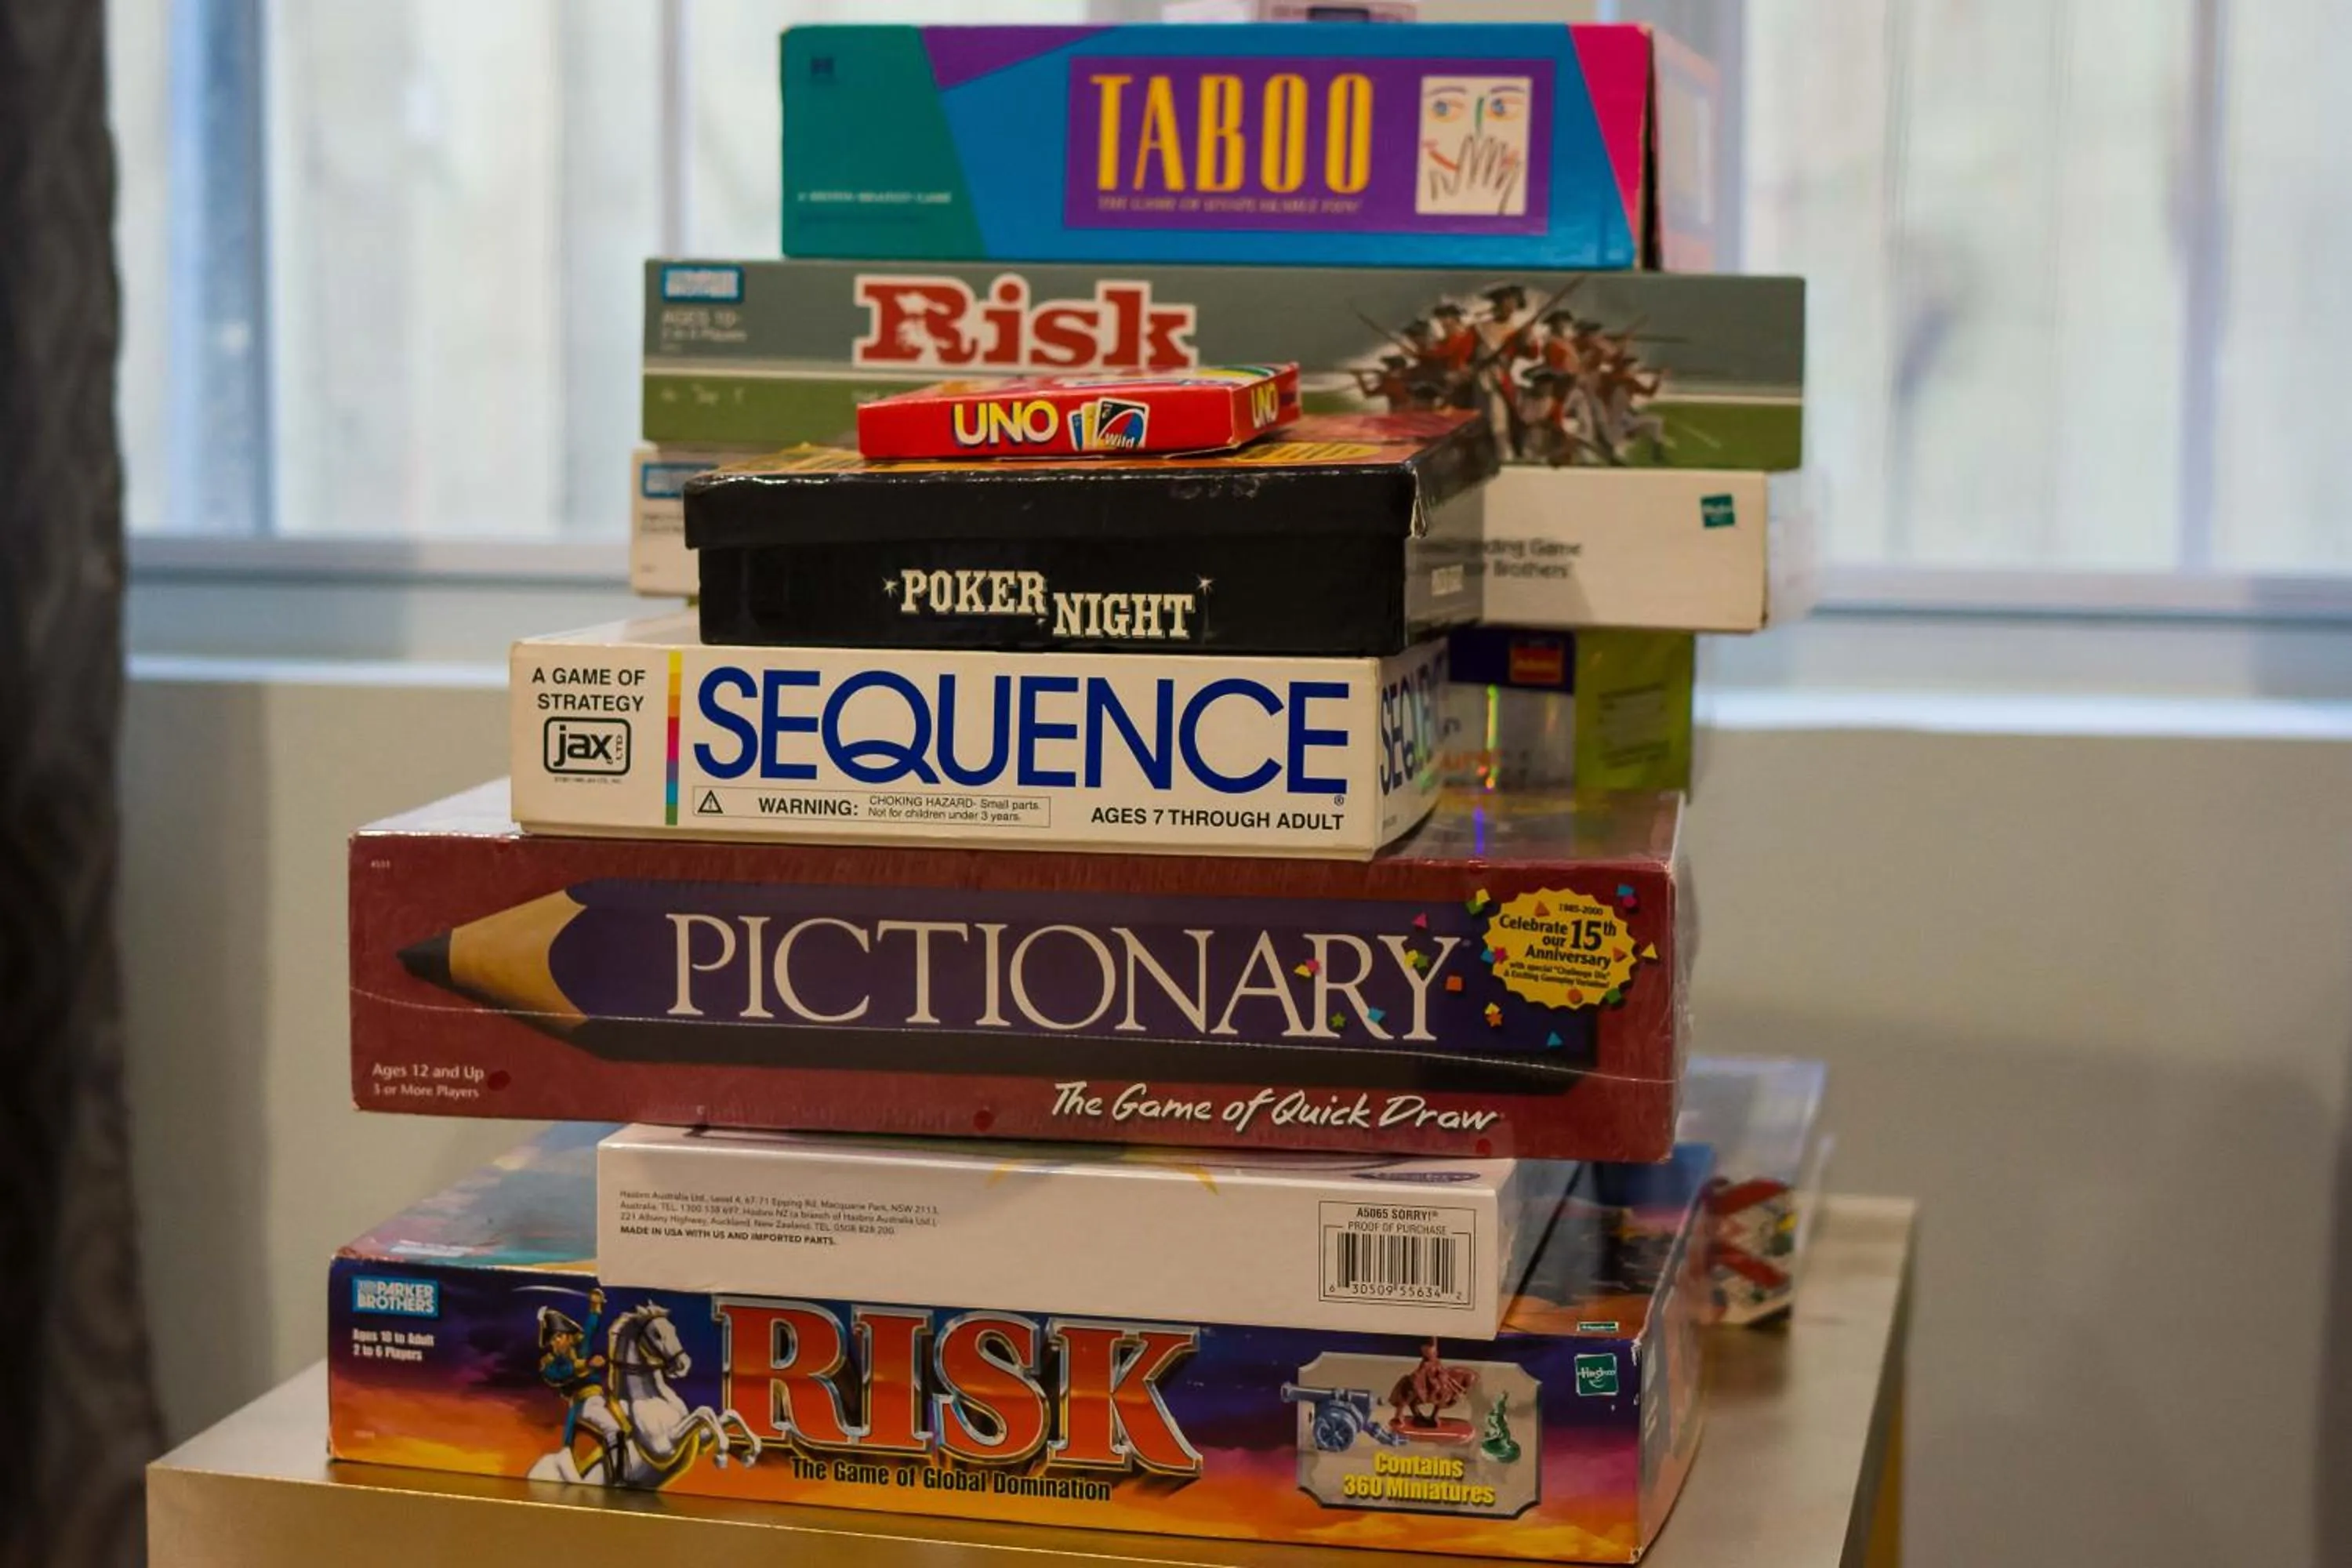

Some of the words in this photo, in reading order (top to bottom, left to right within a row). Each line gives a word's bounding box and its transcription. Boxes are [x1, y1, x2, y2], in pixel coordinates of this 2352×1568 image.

[1091, 73, 1374, 194] TABOO
[853, 274, 1200, 372] Risk
[1251, 383, 1279, 429] UNO
[952, 401, 1058, 447] UNO
[900, 569, 1048, 615] POKER
[1053, 593, 1196, 639] NIGHT
[532, 667, 546, 684] A
[552, 668, 612, 685] GAME
[618, 670, 646, 686] OF
[537, 693, 644, 712] STRATEGY
[694, 666, 1347, 793] SEQUENCE
[554, 724, 613, 767] jax
[758, 797, 858, 816] WARNING:
[869, 795, 923, 807] CHOKING
[981, 798, 1009, 809] Small
[868, 808, 887, 817] Not
[889, 808, 902, 817] for
[905, 808, 946, 819] children
[949, 811, 978, 820] under
[981, 811, 988, 821] 3
[1091, 807, 1146, 826] AGES
[1153, 809, 1164, 825] 7
[1168, 809, 1270, 828] THROUGH
[1276, 812, 1345, 830] ADULT
[1499, 914, 1568, 935] Celebrate
[1542, 934, 1566, 946] our
[1525, 945, 1611, 970] Anniversary
[665, 913, 1461, 1041] PICTIONARY
[372, 1063, 407, 1080] Ages
[412, 1064, 429, 1077] 12
[433, 1065, 459, 1078] and
[463, 1066, 485, 1083] Up
[384, 1085, 397, 1095] or
[401, 1084, 432, 1096] More
[436, 1085, 479, 1101] Players
[1051, 1080, 1103, 1118] The
[1112, 1083, 1212, 1121] Game
[1221, 1088, 1276, 1131] of
[1271, 1088, 1370, 1129] Quick
[1378, 1094, 1498, 1131] Draw
[891, 1203, 913, 1213] NSW
[1356, 1207, 1388, 1219] A5065
[620, 1225, 648, 1235] MADE
[652, 1227, 662, 1236] IN
[664, 1228, 683, 1236] USA
[685, 1229, 711, 1238] WITH
[713, 1230, 725, 1239] US
[728, 1232, 749, 1240] AND
[750, 1232, 802, 1243] IMPORTED
[1348, 1221, 1380, 1232] PROOF
[1382, 1221, 1394, 1233] OF
[1396, 1223, 1448, 1236] PURCHASE
[376, 1280, 434, 1298] PARKER
[1329, 1284, 1336, 1294] 6
[1351, 1284, 1394, 1297] 30509
[1399, 1285, 1442, 1298] 55634
[358, 1294, 434, 1313] BROTHERS
[362, 1344, 373, 1356] to
[385, 1345, 423, 1361] Players
[712, 1294, 1203, 1479] RISK
[1374, 1451, 1465, 1480] Contains
[792, 1457, 826, 1481] The
[833, 1460, 889, 1486] Game
[896, 1466, 916, 1487] of
[923, 1468, 986, 1494] Global
[993, 1471, 1112, 1501] Domination
[1343, 1474, 1383, 1499] 360
[1386, 1475, 1495, 1506] Miniatures
